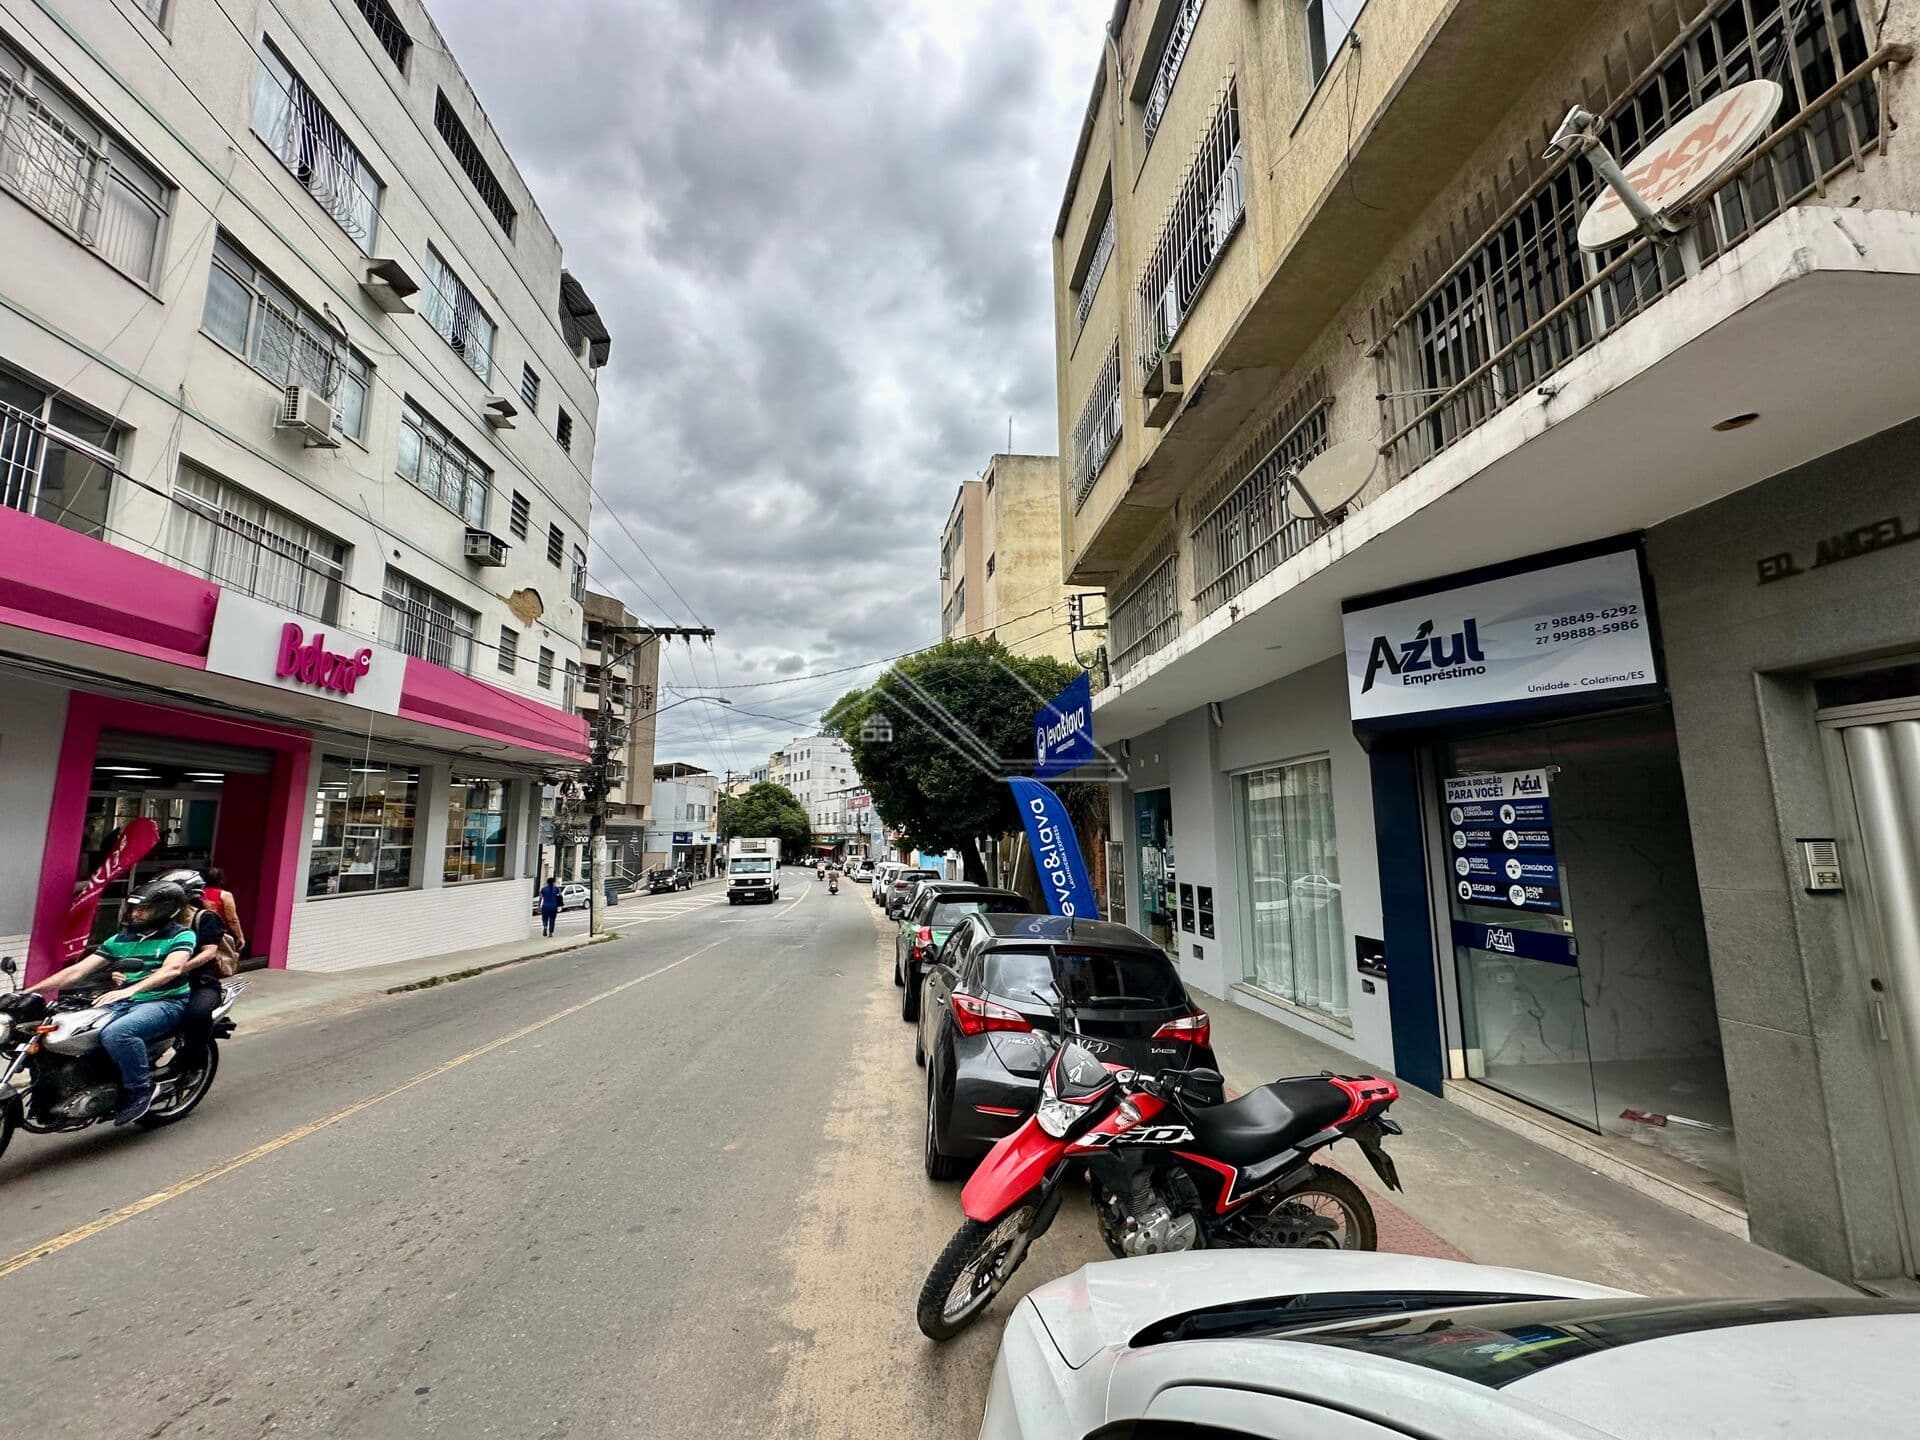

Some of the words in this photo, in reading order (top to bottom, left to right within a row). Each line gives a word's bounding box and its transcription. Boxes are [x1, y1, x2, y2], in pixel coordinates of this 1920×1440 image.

[1810, 515, 1920, 569] ANGEL
[1535, 622, 1547, 631] 27
[1551, 604, 1638, 628] 98849-6292
[1535, 636, 1549, 645] 27
[1552, 619, 1640, 642] 99888-5986
[276, 622, 357, 694] Beleza
[1361, 618, 1484, 694] Azul
[1403, 665, 1486, 686] Empréstimo
[1527, 681, 1569, 693] Unidade
[1580, 670, 1645, 686] Colatina/ES
[1046, 705, 1084, 749] leva&lava
[1448, 788, 1473, 800] PARA
[1512, 774, 1542, 796] Azul
[1029, 797, 1075, 917] eva&lava
[1485, 929, 1514, 950] Azul
